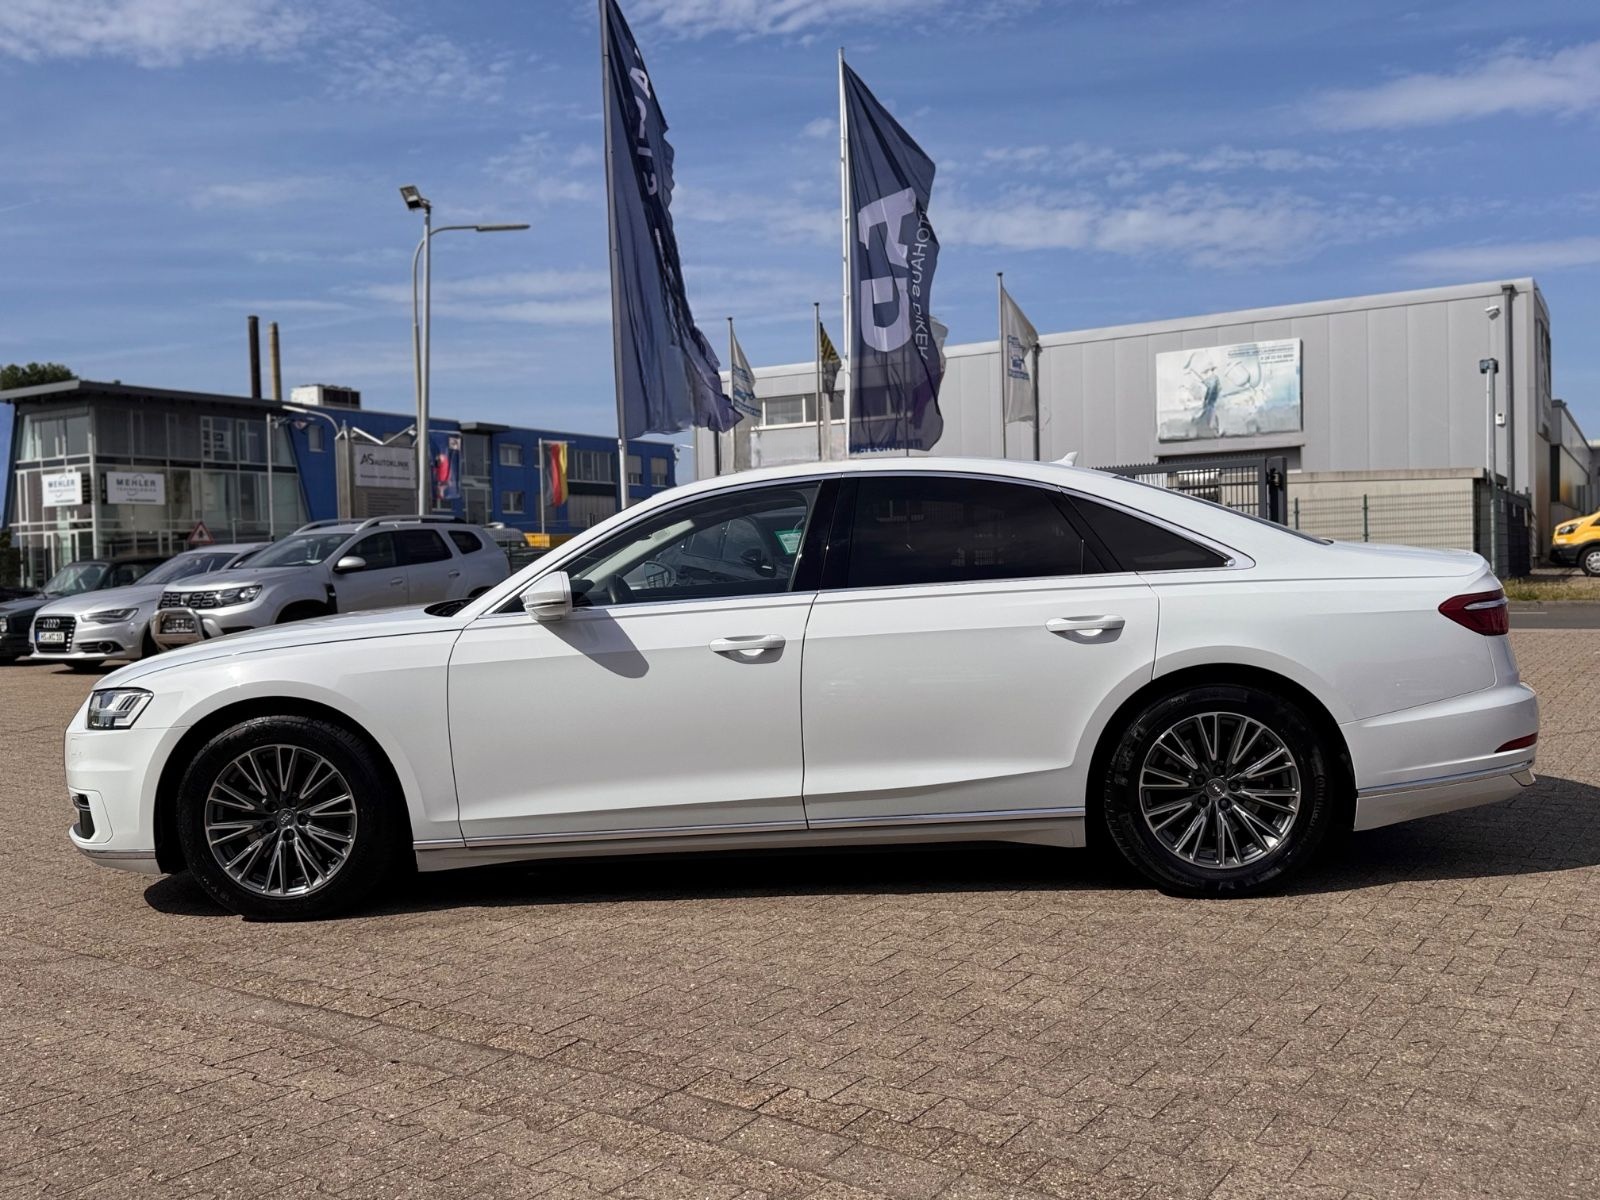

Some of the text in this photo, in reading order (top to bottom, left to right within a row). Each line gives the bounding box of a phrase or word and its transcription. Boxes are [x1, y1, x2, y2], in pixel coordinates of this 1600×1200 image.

[360, 453, 374, 465] AS
[48, 479, 75, 488] MEHLER
[116, 478, 156, 487] MEHLER
